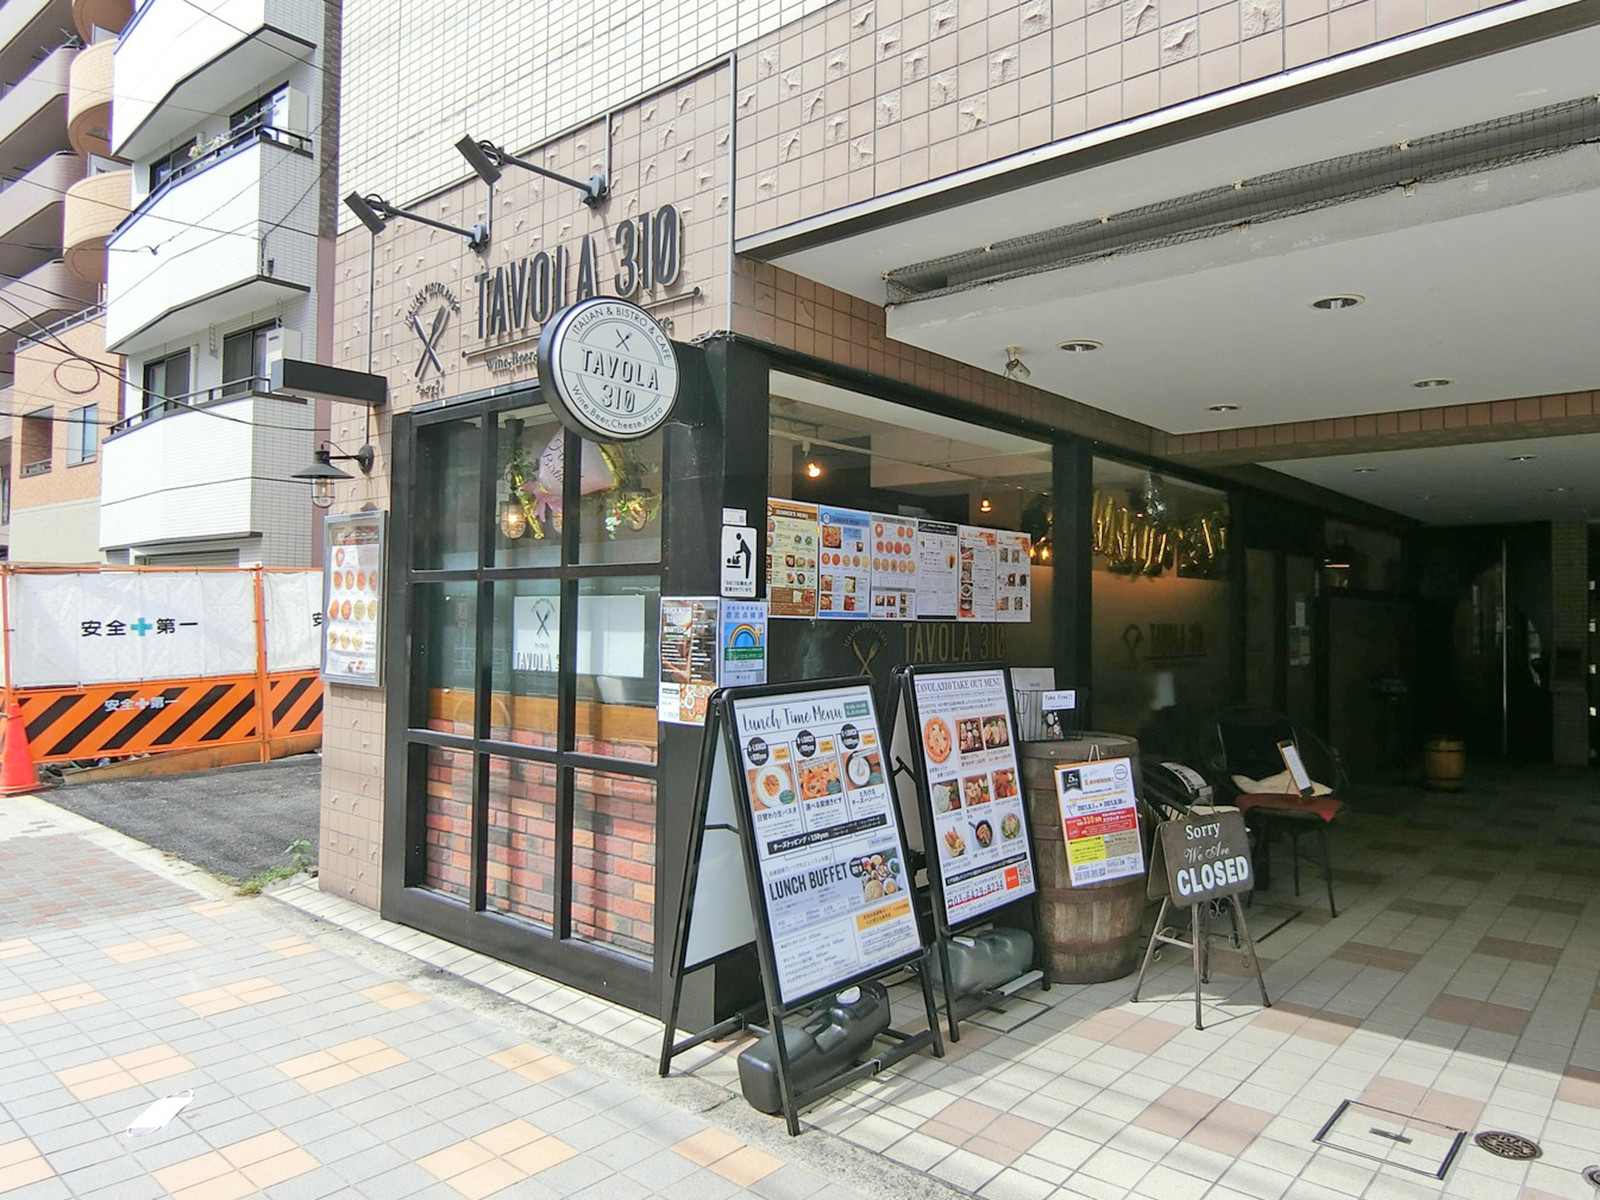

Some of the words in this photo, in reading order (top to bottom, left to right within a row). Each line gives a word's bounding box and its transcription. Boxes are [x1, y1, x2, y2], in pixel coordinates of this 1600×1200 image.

[474, 234, 600, 339] TAVOLA
[613, 203, 683, 303] 310
[572, 307, 604, 335] ITALIAN
[606, 306, 613, 316] &
[616, 307, 648, 327] BISTRO
[648, 325, 655, 335] &
[655, 335, 672, 361] CAFE
[581, 347, 660, 392] TAVOLA
[603, 384, 636, 413] 310
[81, 619, 128, 638] 安全
[156, 618, 199, 635] 第一
[903, 623, 972, 664] TAVOLA
[980, 623, 1007, 660] 310
[953, 679, 970, 691] TAKE
[970, 679, 983, 689] OUT
[984, 677, 1003, 688] MENU
[104, 698, 134, 712] 安全
[150, 696, 179, 709] 第一
[743, 708, 782, 732] Lunch
[783, 707, 813, 726] Time
[812, 705, 844, 722] Menu
[1185, 822, 1221, 841] Sorry
[1184, 845, 1203, 864] We
[1205, 841, 1230, 860] Are
[769, 874, 807, 902] LUNCH
[808, 862, 848, 890] BUFFET
[1177, 855, 1250, 896] CLOSED
